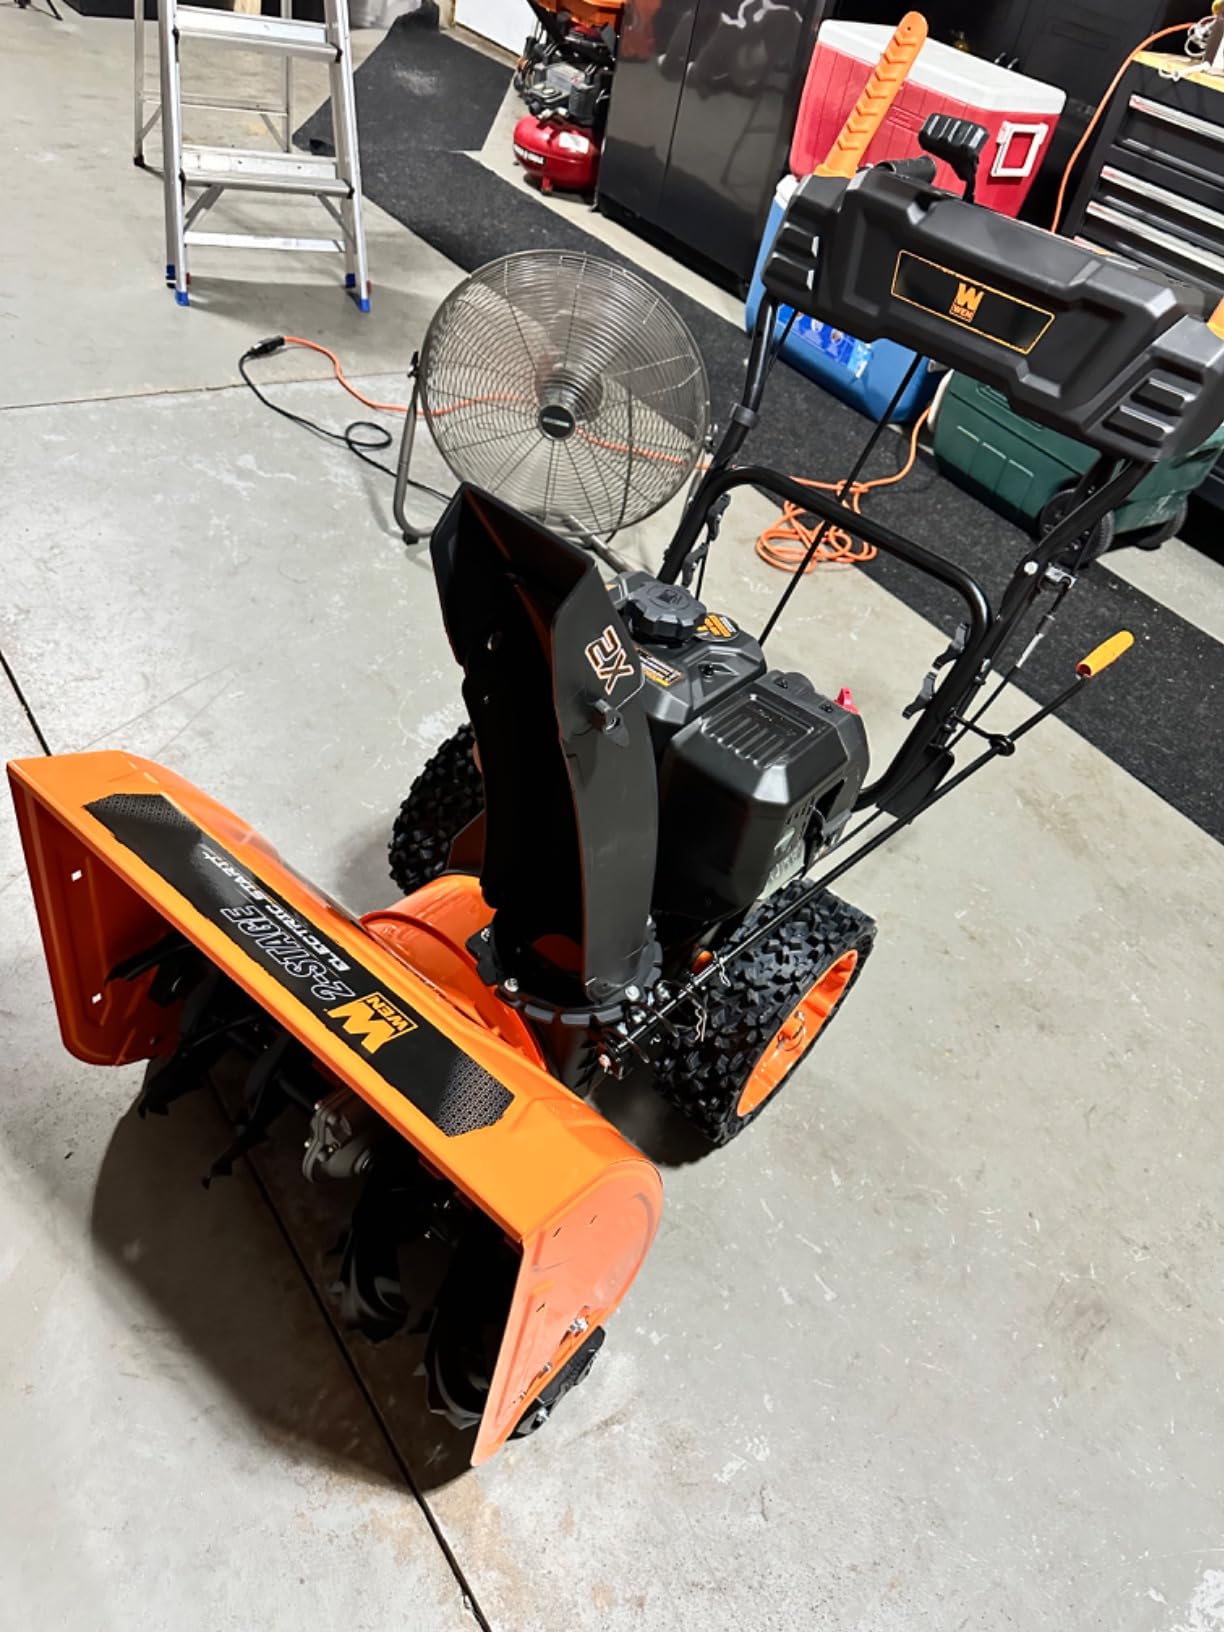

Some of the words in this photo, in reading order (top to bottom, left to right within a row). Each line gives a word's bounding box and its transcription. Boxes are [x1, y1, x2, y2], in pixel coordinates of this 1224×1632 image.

[584, 624, 634, 695] 2X
[220, 905, 355, 1000] 2-STAGE
[265, 904, 351, 971] ELECTRIC
[366, 995, 408, 1031] WEN
